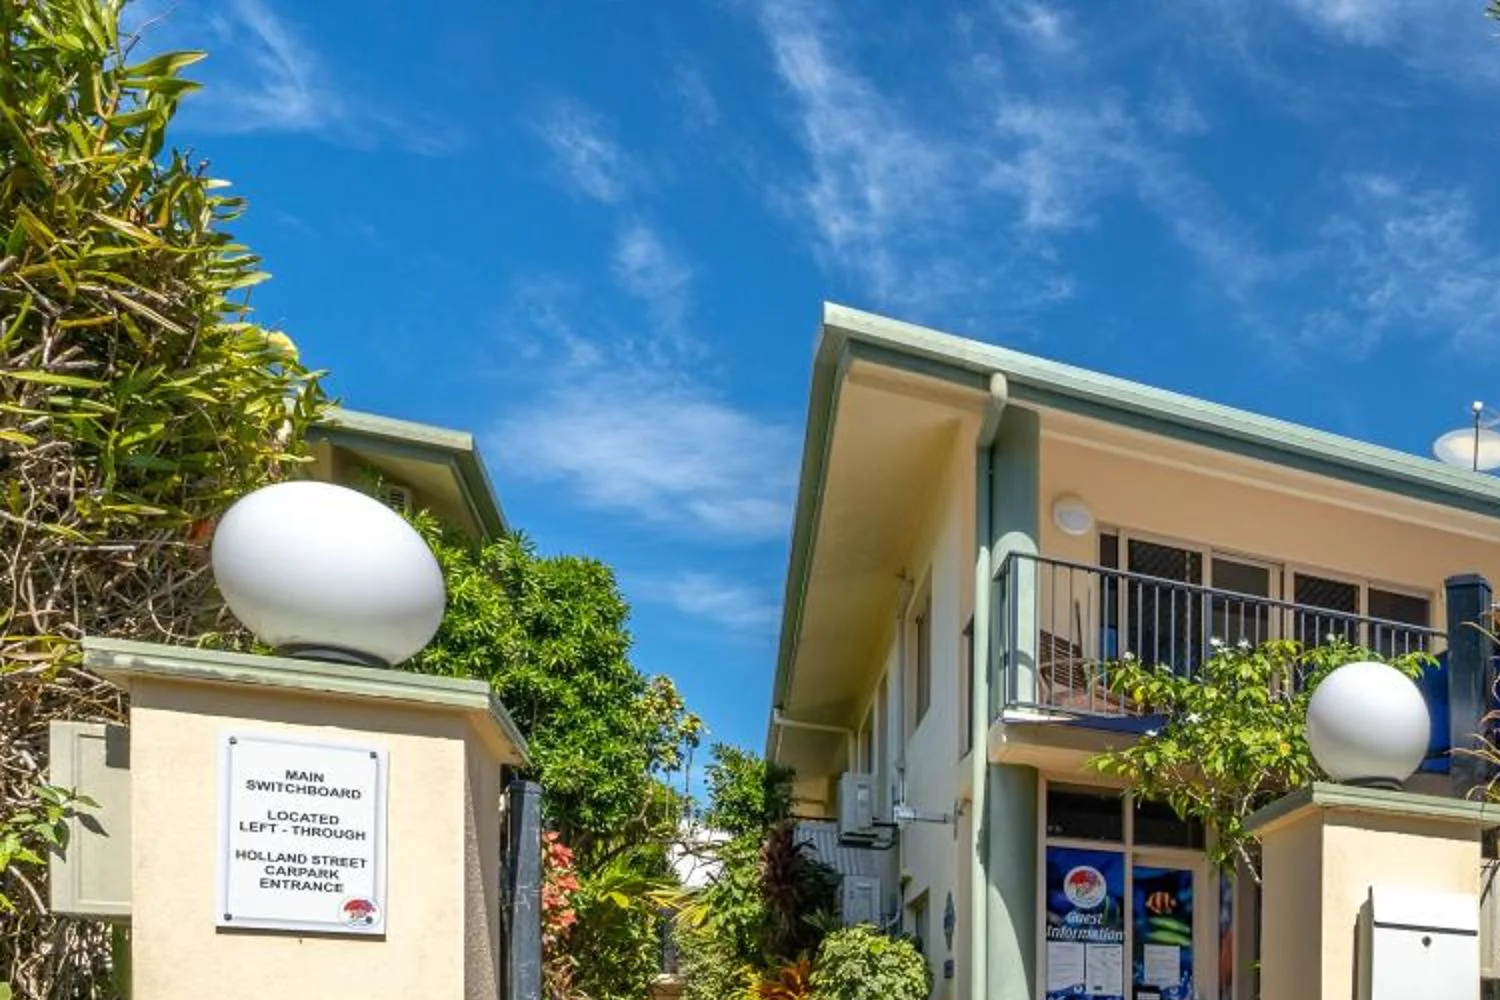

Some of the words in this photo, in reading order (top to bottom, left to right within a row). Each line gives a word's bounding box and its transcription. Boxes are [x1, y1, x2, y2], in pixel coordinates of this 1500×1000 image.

[285, 770, 325, 783] MAIN
[246, 780, 362, 799] SWITCHBOARD
[267, 810, 340, 825] LOCATED
[239, 821, 276, 833] LEFT
[293, 826, 366, 841] THROUGH
[235, 849, 307, 865] HOLLAND
[311, 856, 368, 869] STREET
[264, 865, 340, 880] CARPARK
[259, 878, 344, 893] ENTRANCE
[1066, 911, 1103, 925] Guest
[1047, 925, 1123, 941] Information
